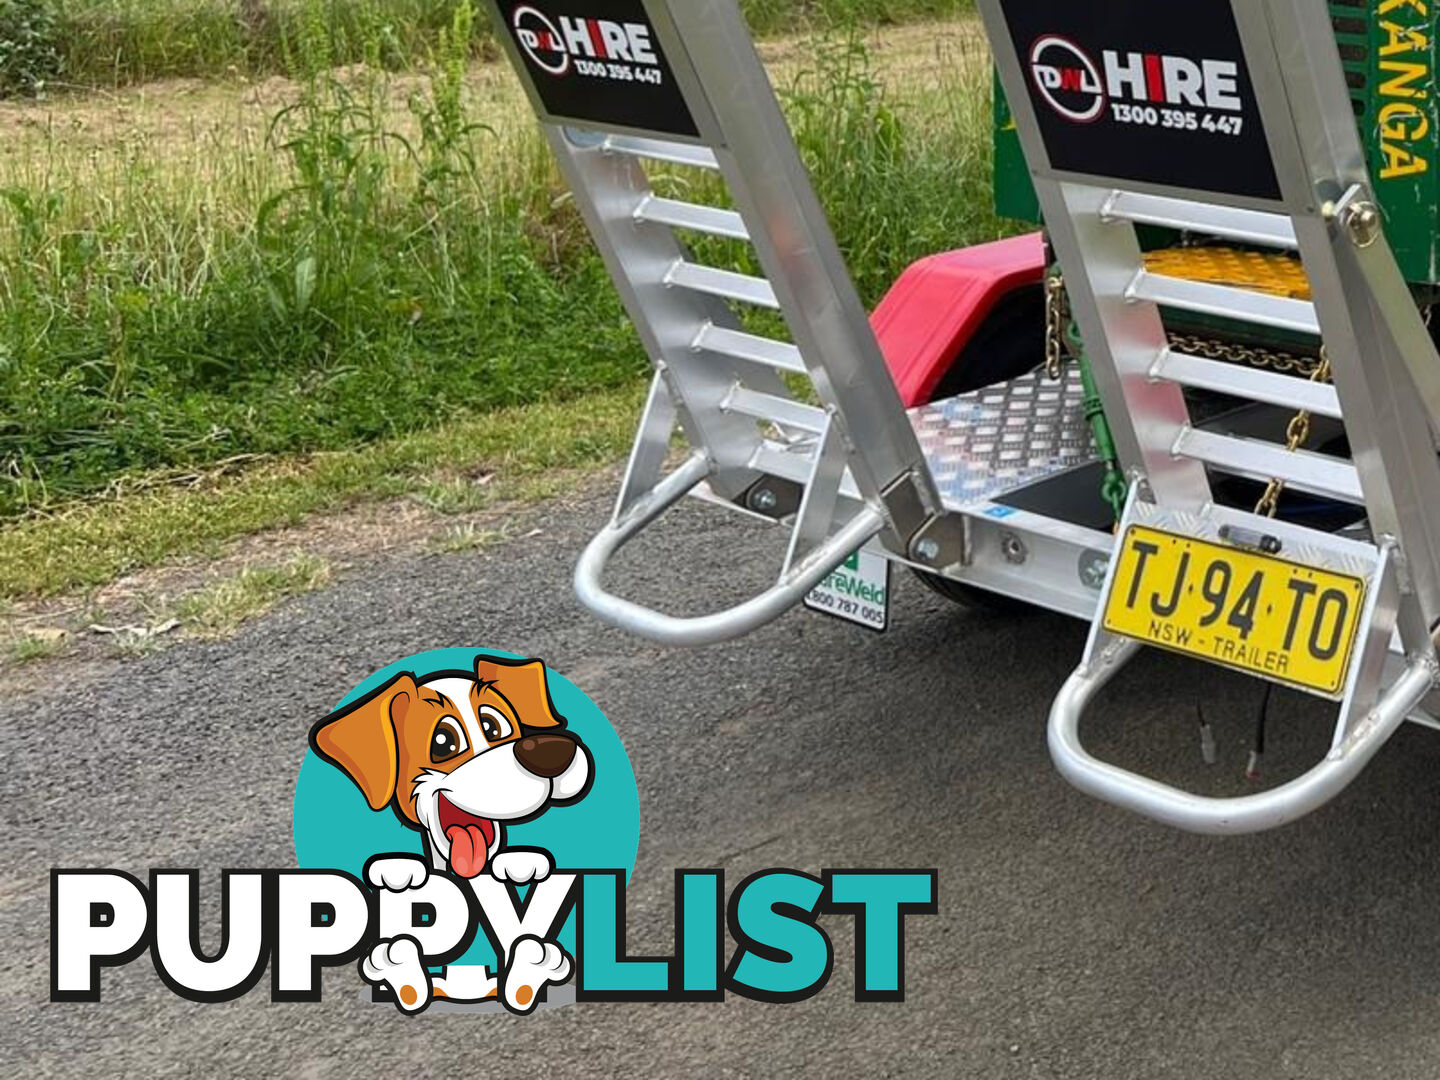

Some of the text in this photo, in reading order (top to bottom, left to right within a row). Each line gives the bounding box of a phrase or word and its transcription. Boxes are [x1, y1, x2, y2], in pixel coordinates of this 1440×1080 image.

[559, 15, 658, 64] HIRE
[574, 59, 662, 84] 1300 395 447
[1102, 50, 1242, 111] HIRE
[1111, 103, 1243, 136] 1300 395 447
[838, 600, 859, 614] 787
[862, 608, 883, 623] 005
[1126, 540, 1191, 617] TJ
[1200, 560, 1264, 640] 94
[1148, 620, 1192, 646] NSW
[1213, 637, 1290, 674] TRAILER
